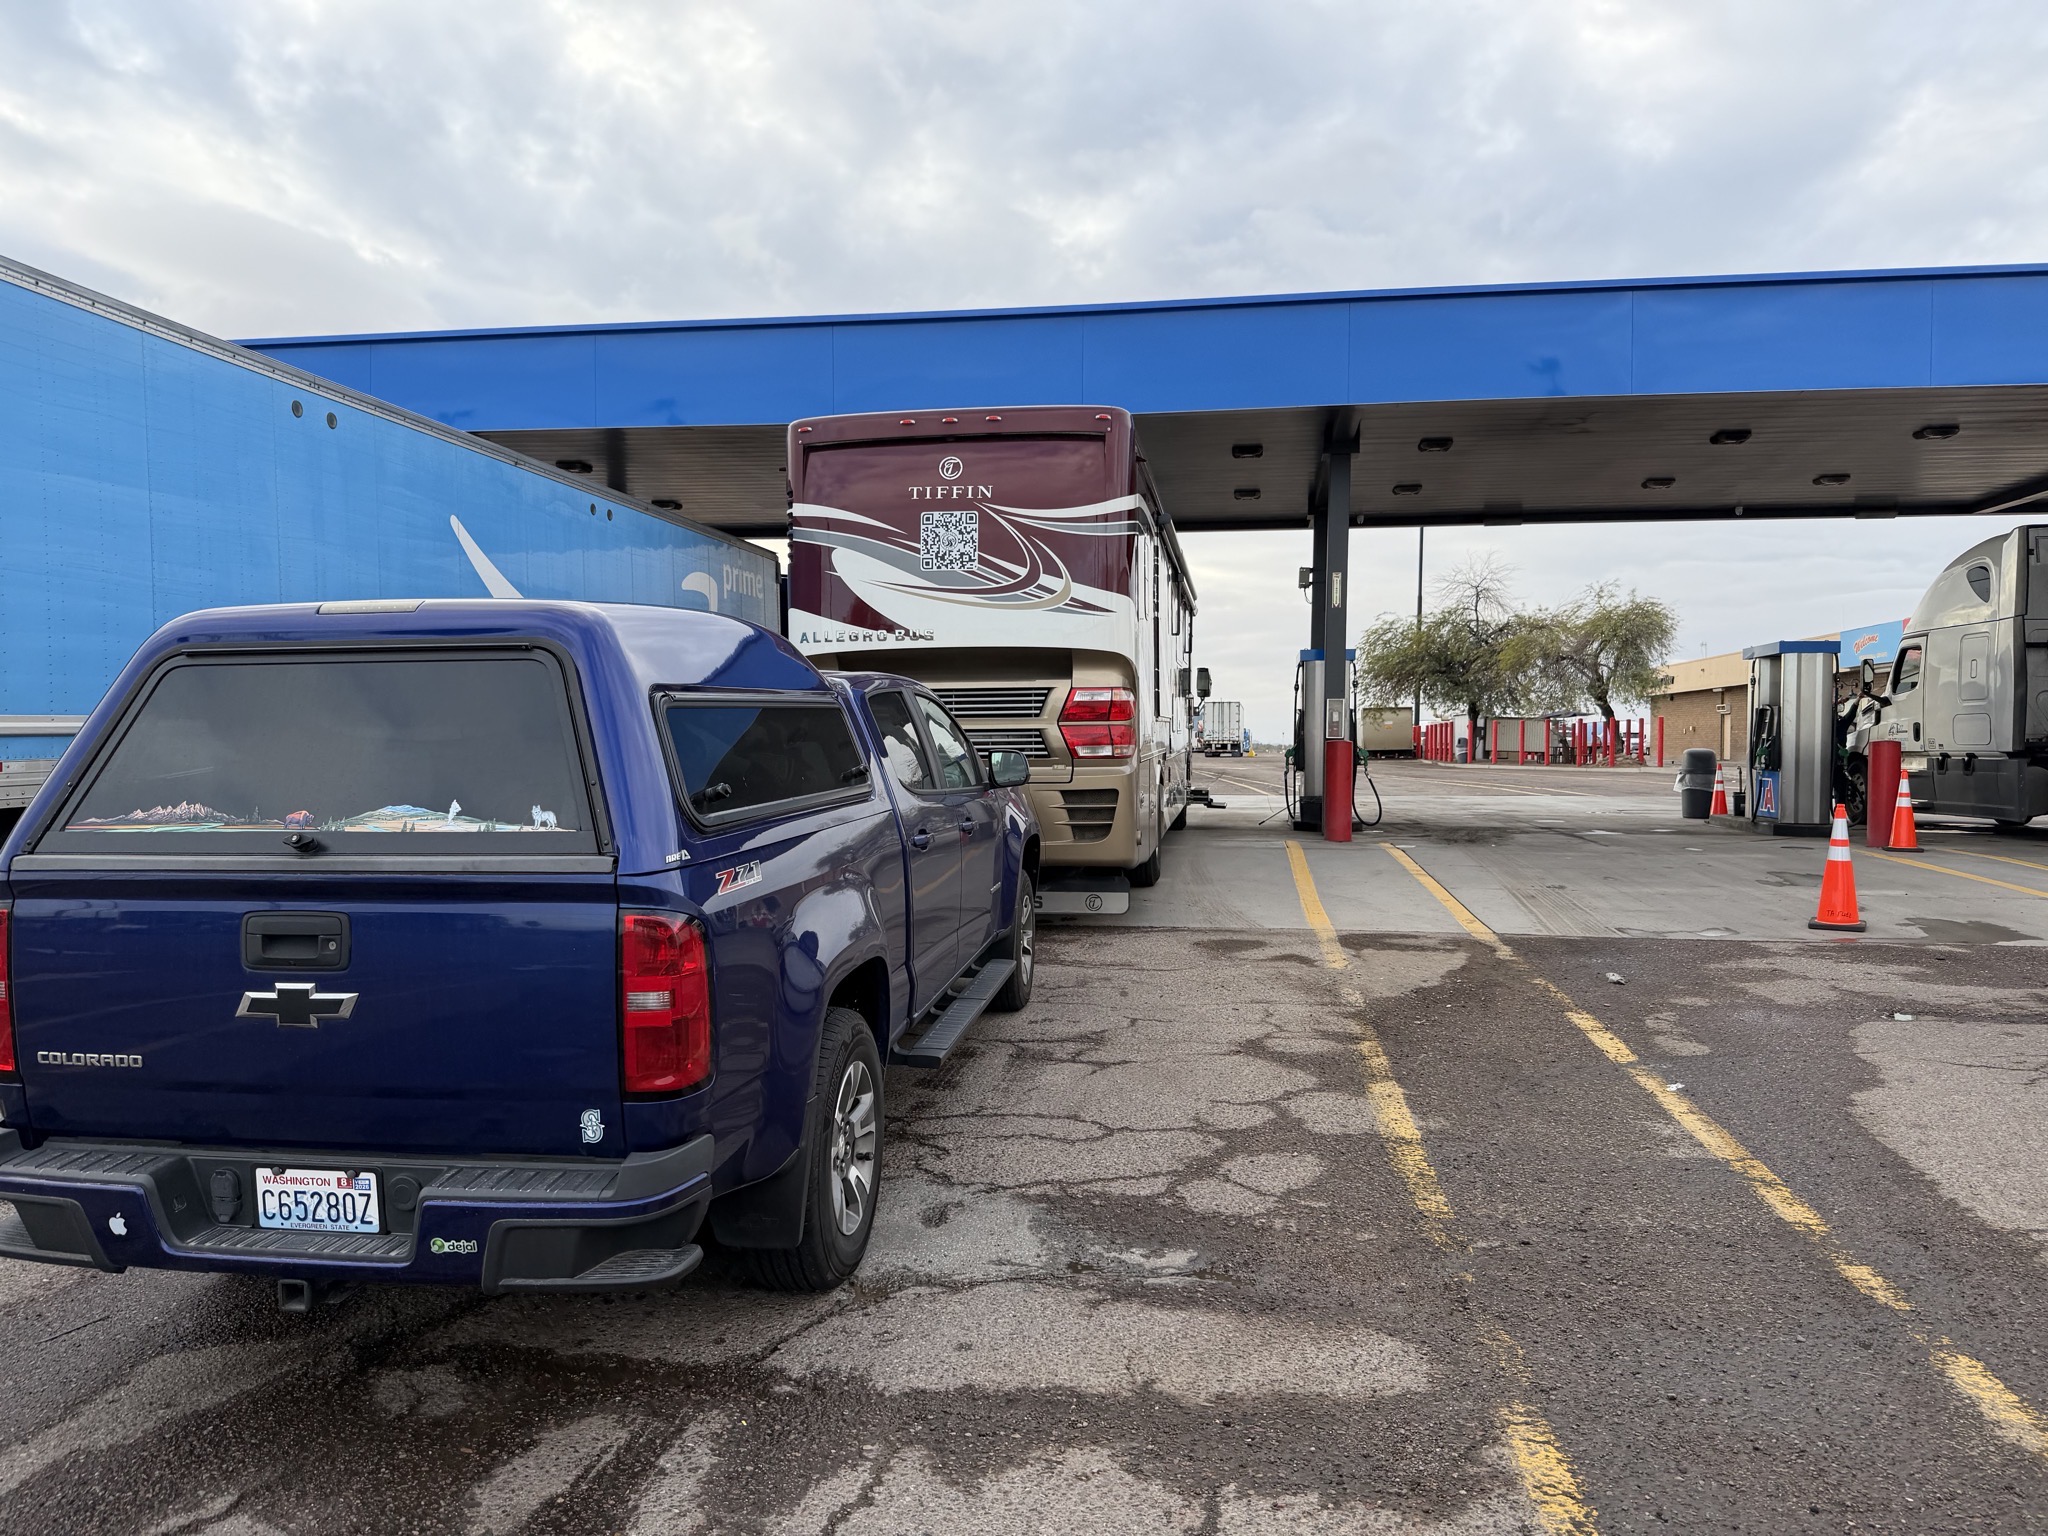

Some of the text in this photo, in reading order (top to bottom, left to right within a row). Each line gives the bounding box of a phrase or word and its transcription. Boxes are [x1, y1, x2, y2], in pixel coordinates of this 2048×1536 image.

[908, 485, 993, 500] TIFFIN
[722, 563, 764, 600] prime
[799, 628, 935, 644] ALLEGRO BUS
[715, 859, 763, 896] Z71
[37, 1051, 143, 1068] COLORADO
[262, 1175, 331, 1187] WASHINGTON
[340, 1177, 348, 1186] 8
[261, 1189, 374, 1225] C65280Z
[290, 1222, 350, 1231] EVERGREEN STATE
[447, 1241, 476, 1252] dejal
